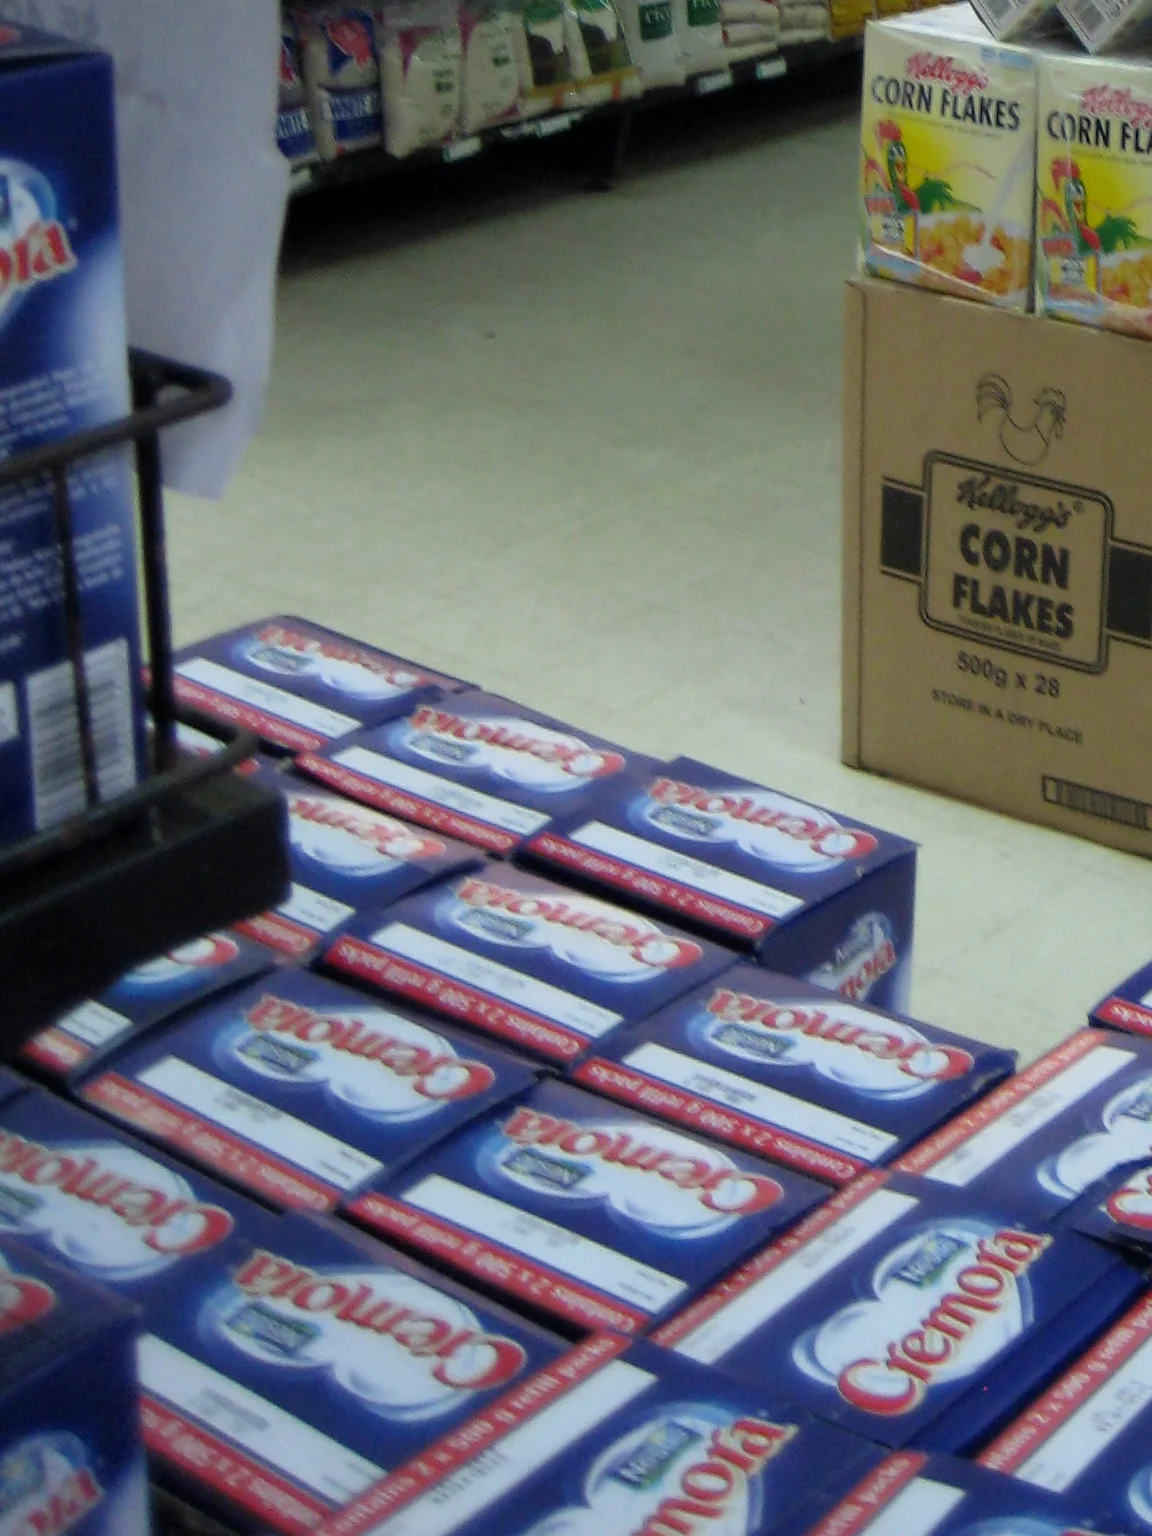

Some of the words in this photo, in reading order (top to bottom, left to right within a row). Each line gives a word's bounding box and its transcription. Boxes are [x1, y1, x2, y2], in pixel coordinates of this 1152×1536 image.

[870, 75, 933, 114] CORN
[940, 87, 1021, 133] FLAKES
[1046, 111, 1111, 149] CORN
[955, 474, 1073, 534] Kellogg's
[958, 522, 1071, 591] CORN
[952, 573, 1076, 641] FLAKES
[956, 651, 1009, 690] 500g
[1013, 673, 1028, 690] x
[1033, 674, 1061, 699] 28
[931, 688, 975, 715] STORE
[978, 701, 993, 716] IN
[995, 705, 1005, 720] A
[1007, 708, 1036, 731] DRY
[1039, 715, 1084, 745] PLACE
[648, 777, 880, 860] Cremora
[243, 992, 497, 1102] Cremora
[704, 987, 976, 1083] Cremora
[502, 1105, 785, 1215] Cremora
[234, 1247, 528, 1392] Cremora
[836, 1226, 1055, 1418] Cremora
